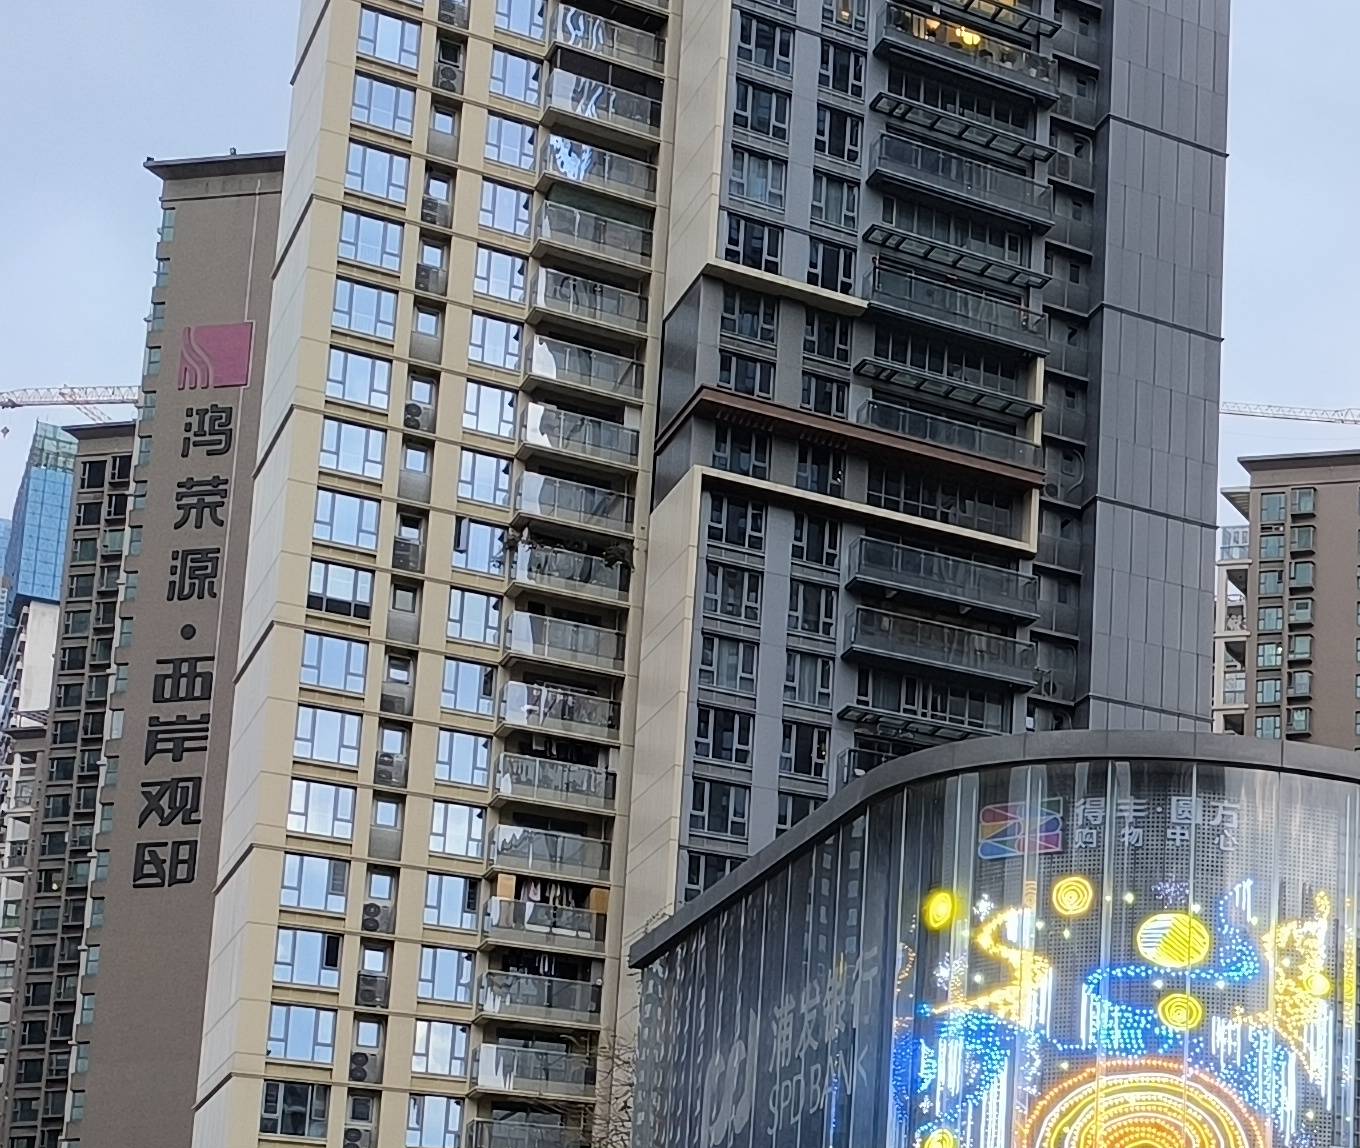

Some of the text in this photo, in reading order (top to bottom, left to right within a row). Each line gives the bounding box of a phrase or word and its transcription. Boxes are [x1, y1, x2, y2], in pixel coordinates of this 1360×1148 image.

[1074, 824, 1240, 851] 购物中心
[769, 945, 879, 1073] 浦发银行
[766, 1044, 870, 1136] SPD BANK
